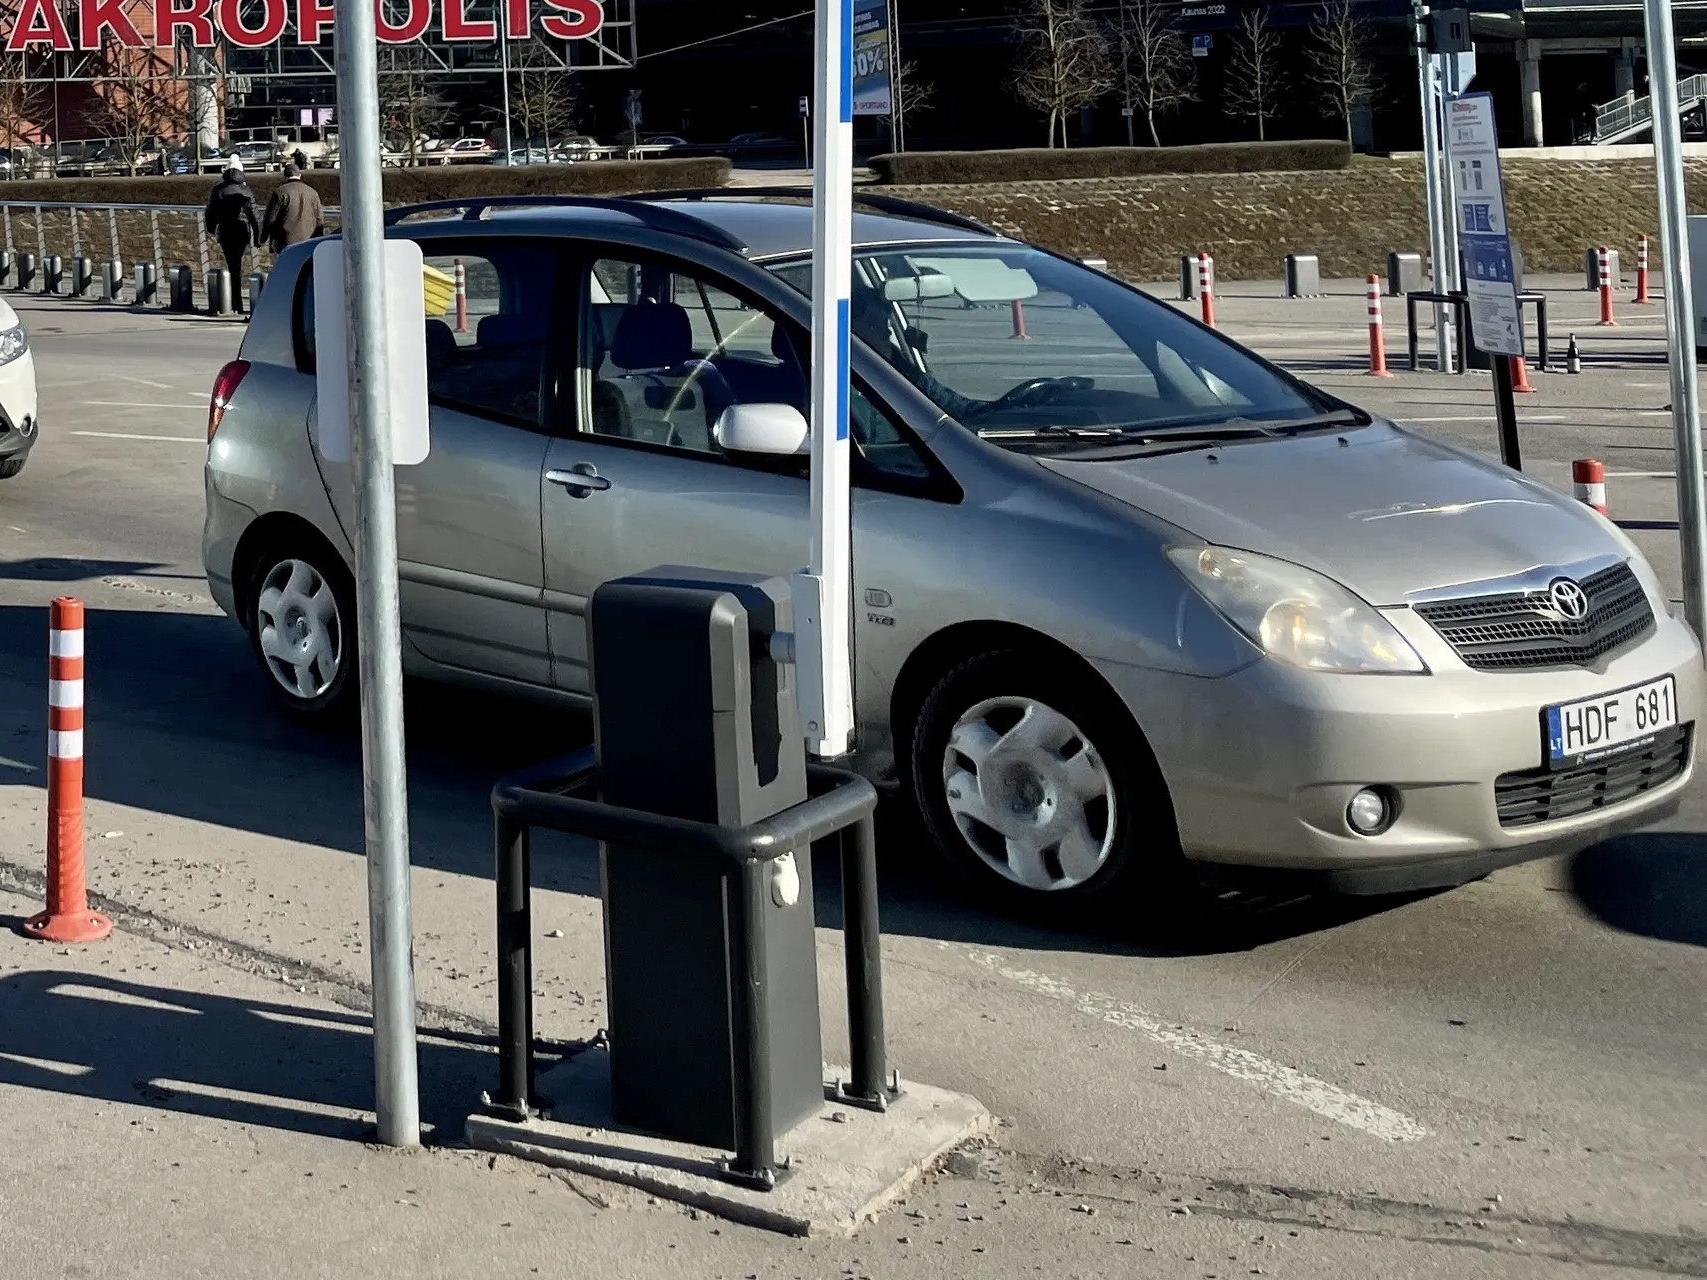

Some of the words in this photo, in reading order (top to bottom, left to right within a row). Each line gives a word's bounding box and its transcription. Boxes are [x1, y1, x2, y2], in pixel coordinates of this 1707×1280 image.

[1181, 8, 1206, 16] Kaunas
[1207, 5, 1226, 15] 2022
[1566, 700, 1619, 749] HDF
[1635, 684, 1670, 730] 681
[1550, 738, 1562, 751] LT
